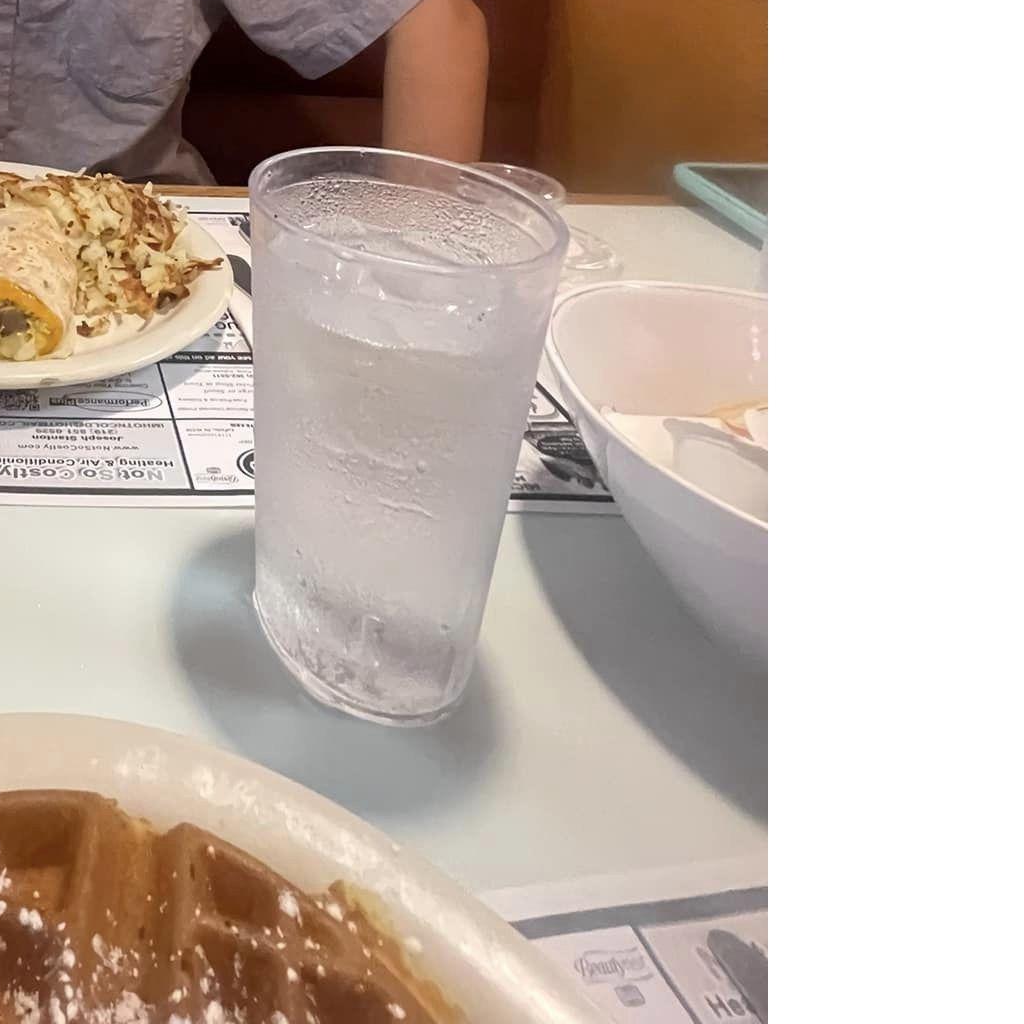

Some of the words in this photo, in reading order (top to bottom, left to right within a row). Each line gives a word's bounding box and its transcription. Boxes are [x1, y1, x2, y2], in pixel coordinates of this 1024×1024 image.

[31, 434, 77, 442] Stanton
[80, 459, 100, 467] Air
[104, 459, 114, 467] &
[119, 458, 174, 468] Heating
[82, 468, 114, 481] So
[121, 469, 163, 481] Not
